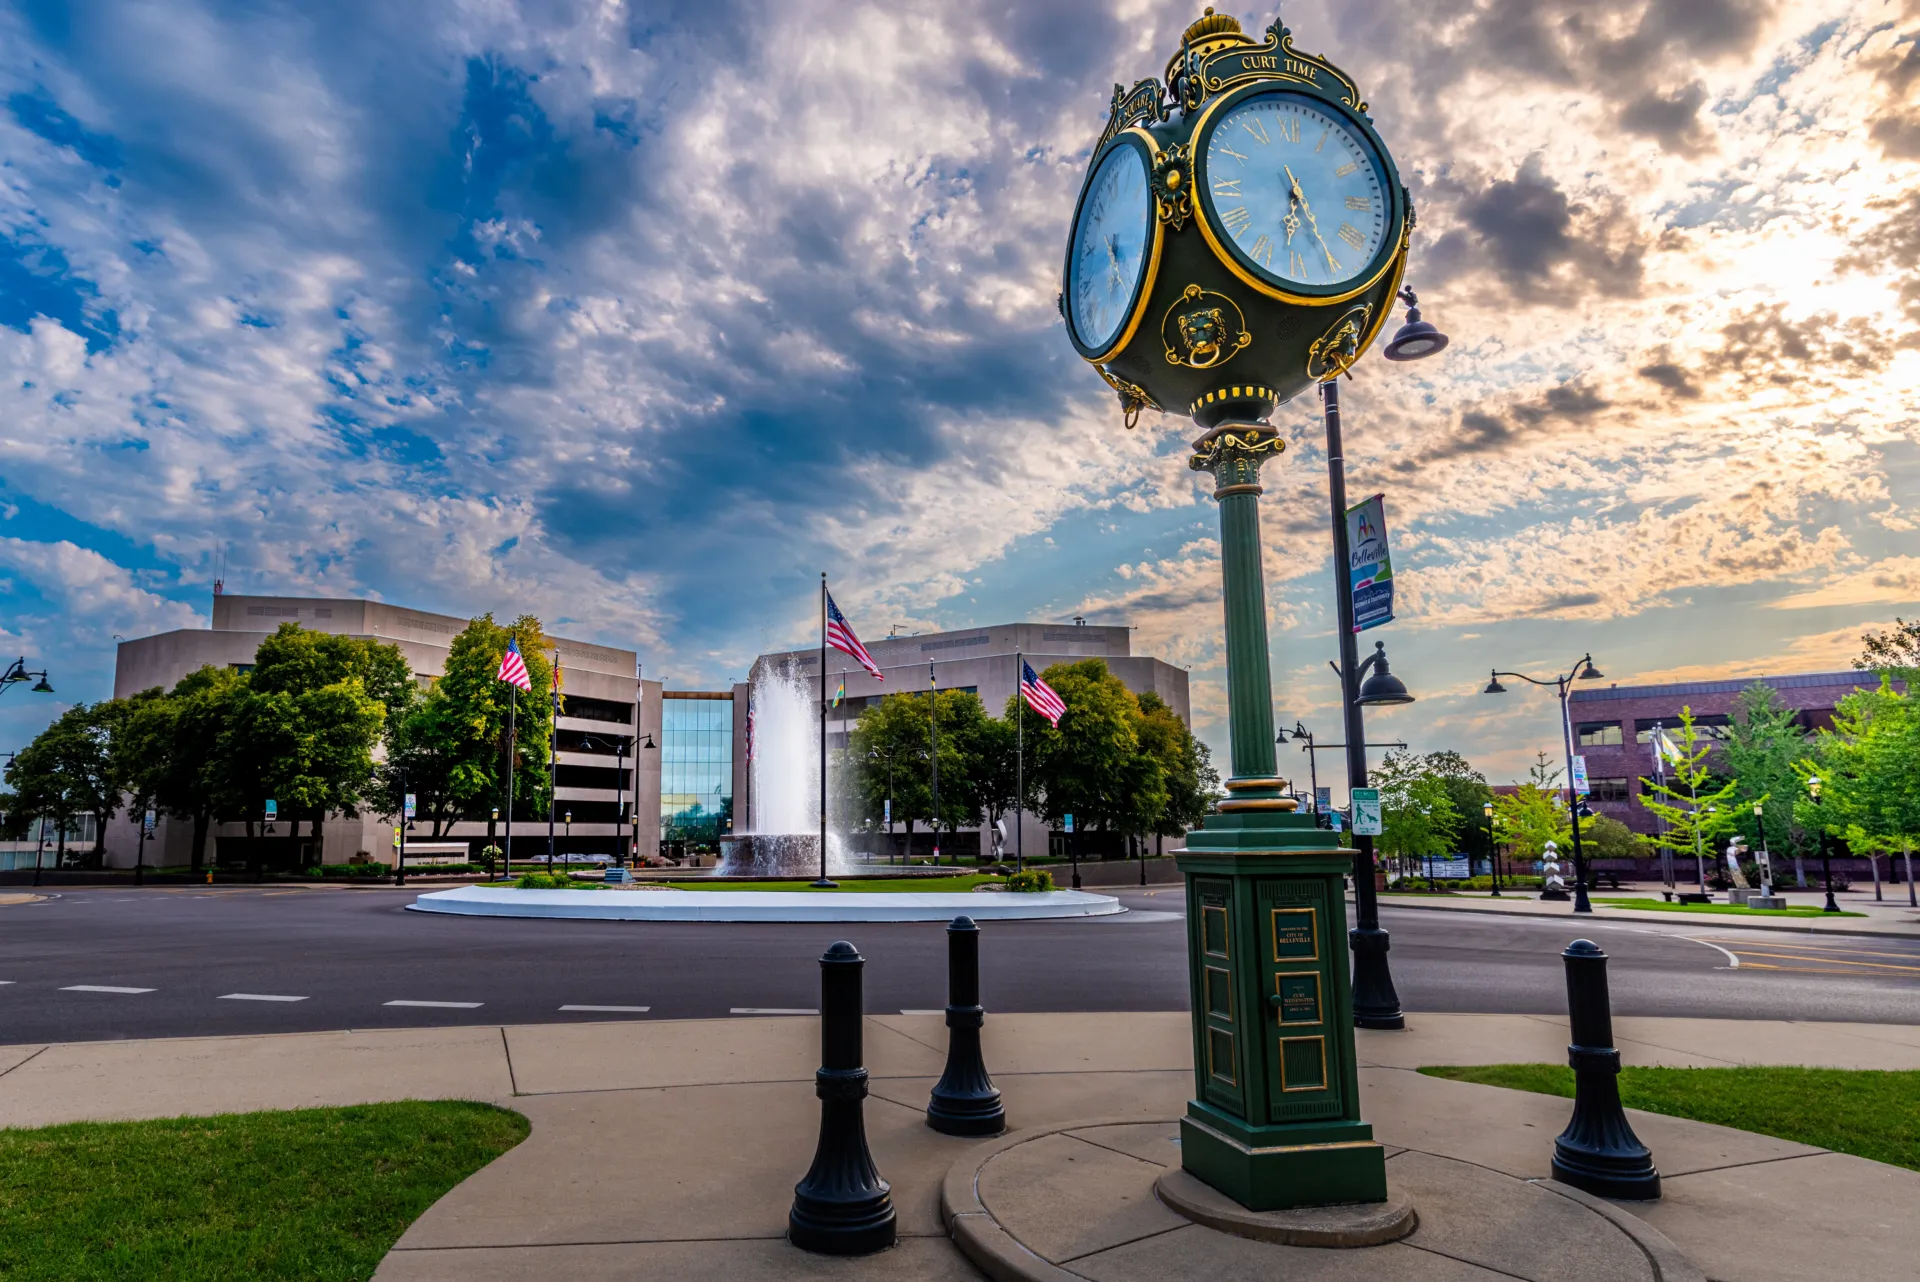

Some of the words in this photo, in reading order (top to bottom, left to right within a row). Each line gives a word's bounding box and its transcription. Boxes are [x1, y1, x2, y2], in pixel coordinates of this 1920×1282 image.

[1241, 56, 1277, 69] CURT
[1284, 58, 1318, 80] TIME
[1124, 93, 1150, 117] SQUARE
[1351, 544, 1387, 568] Belleville
